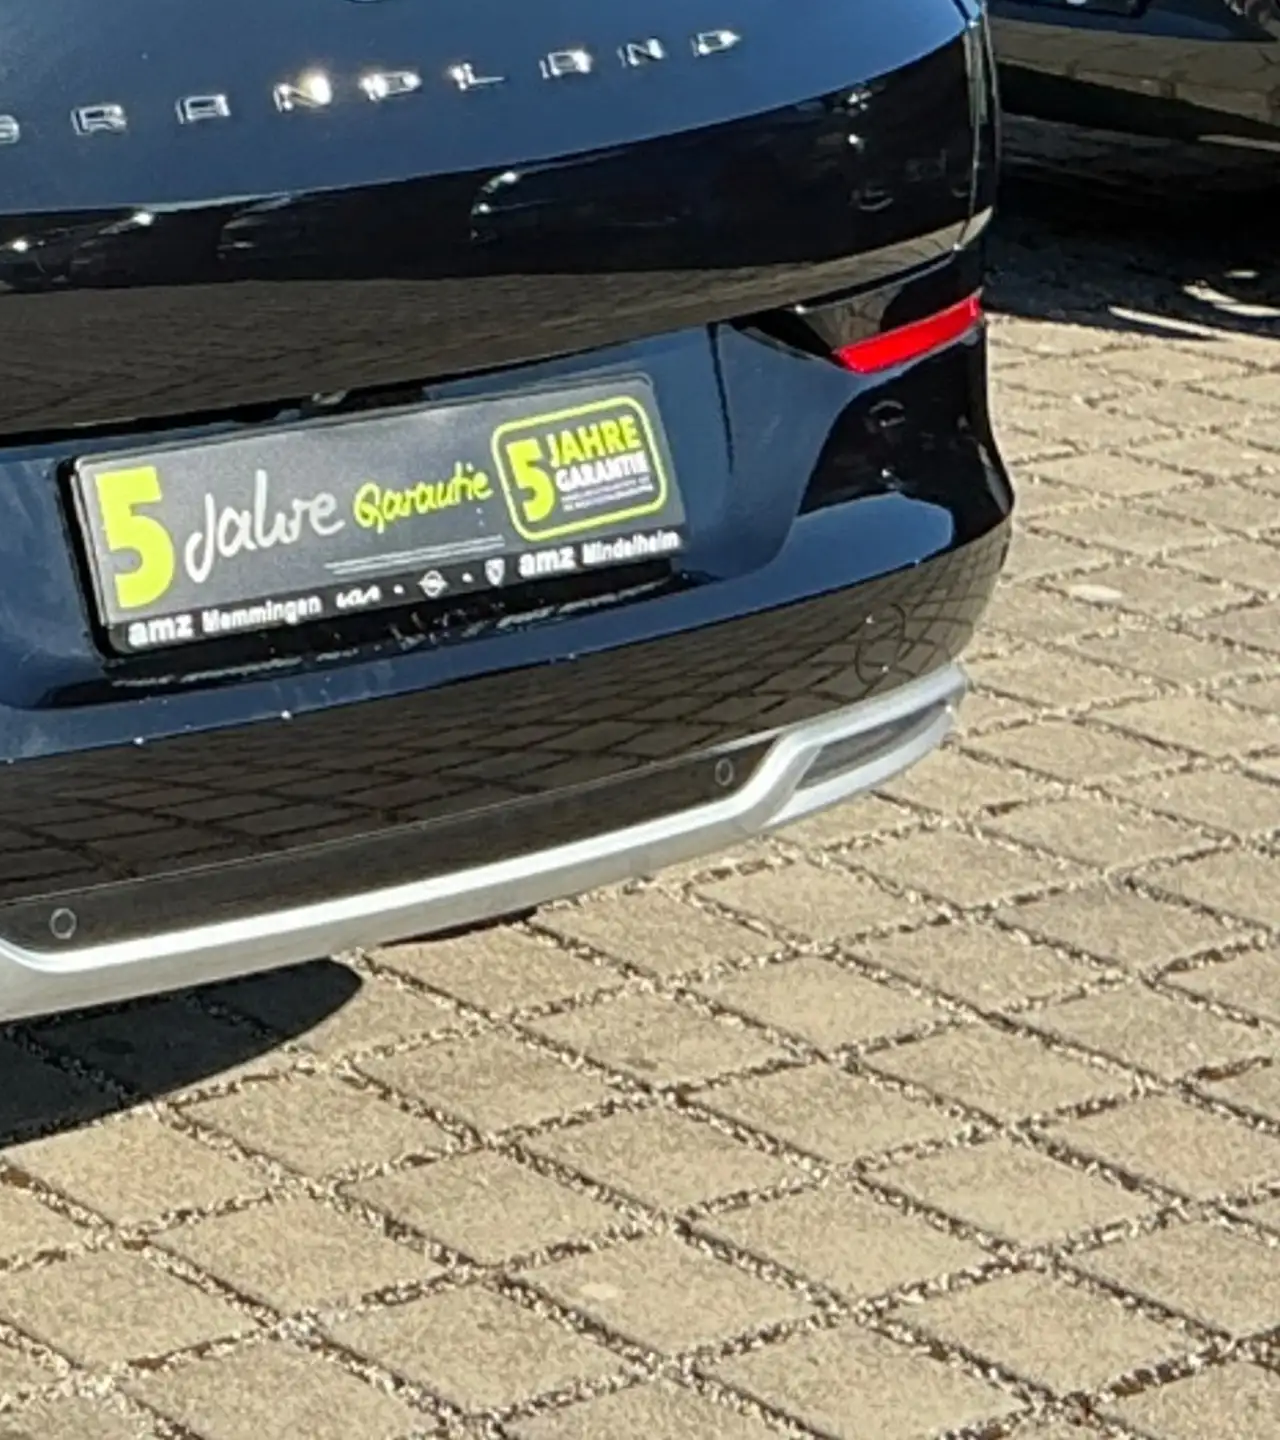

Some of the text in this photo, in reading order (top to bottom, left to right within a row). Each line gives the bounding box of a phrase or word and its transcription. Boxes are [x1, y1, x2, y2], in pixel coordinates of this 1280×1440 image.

[506, 437, 555, 522] 5
[545, 414, 642, 468] JAHRE
[555, 450, 650, 492] GARANTIE
[95, 461, 494, 608] 5 Jahre Garantie
[128, 612, 195, 647] amz
[202, 595, 322, 633] Memmingen
[518, 545, 577, 579] amz
[582, 528, 681, 565] Mindelheim
